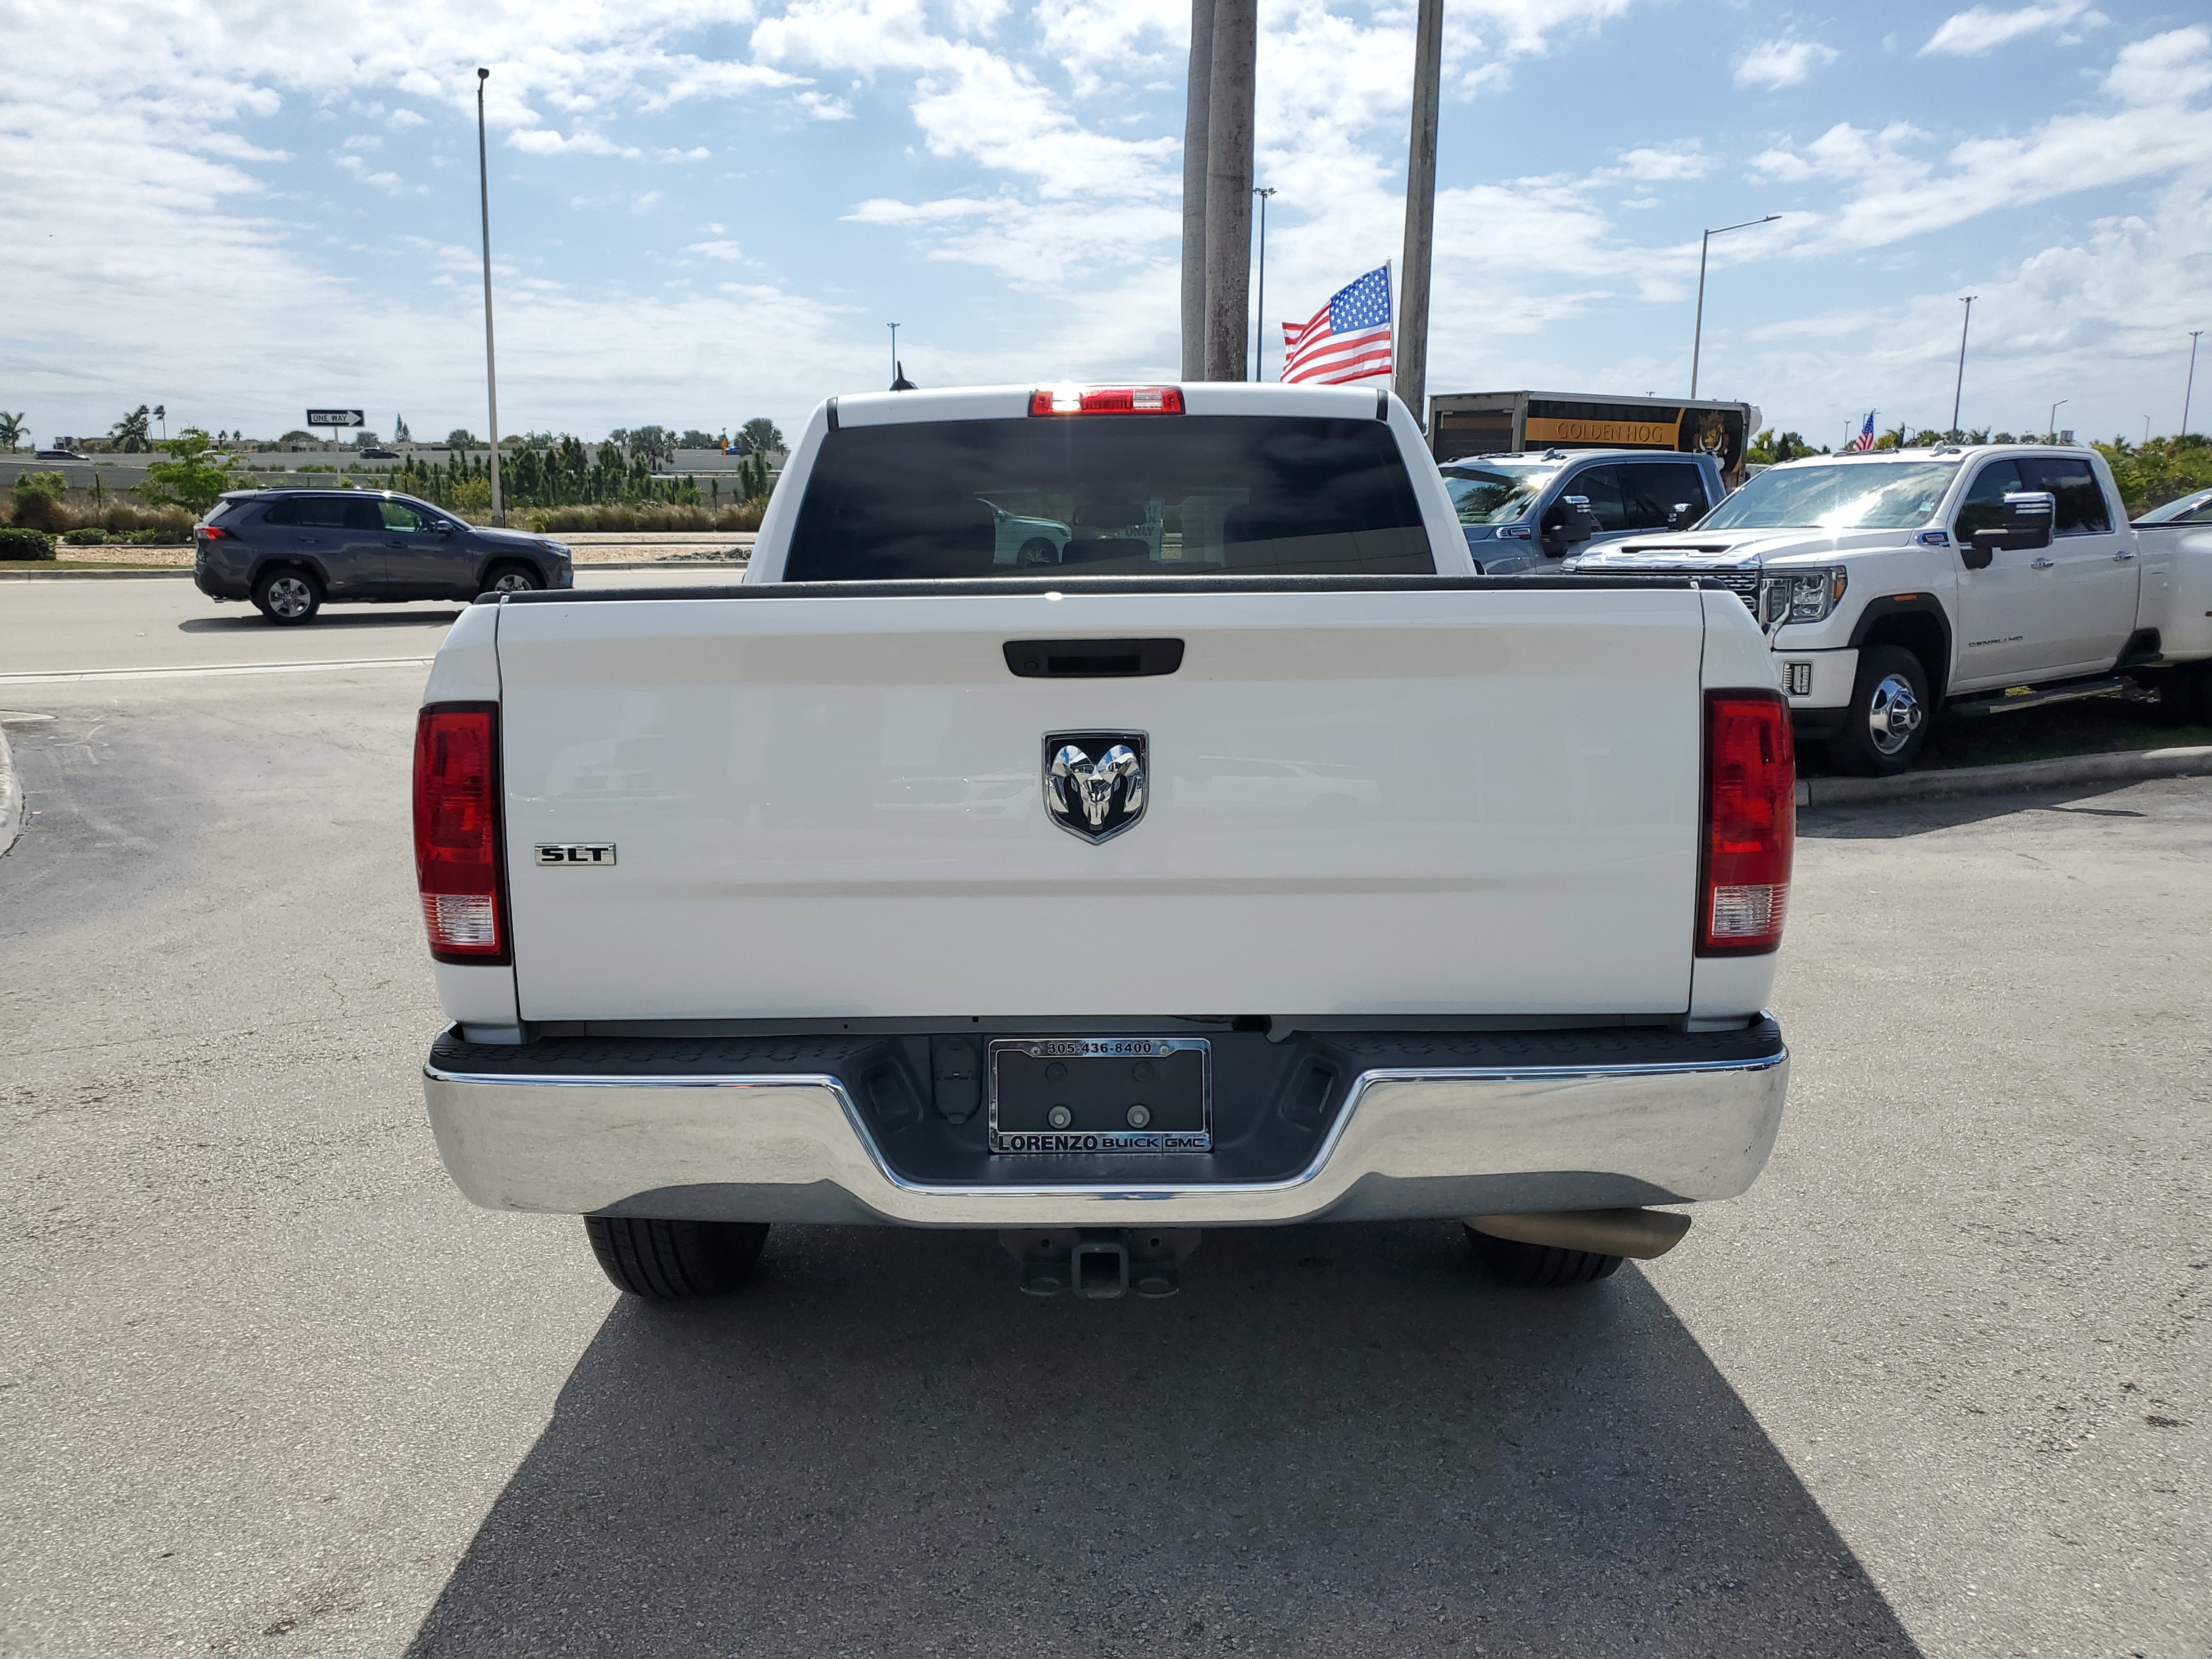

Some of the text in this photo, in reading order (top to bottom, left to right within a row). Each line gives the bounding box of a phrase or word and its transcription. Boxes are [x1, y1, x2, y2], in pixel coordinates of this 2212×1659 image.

[1558, 423, 1662, 442] GOLDEN HOG
[1126, 526, 1154, 536] ONLY
[542, 848, 609, 861] SLT
[1048, 1043, 1151, 1053] 305-436-8400
[998, 1136, 1205, 1150] LORENZO BUICK GMC
